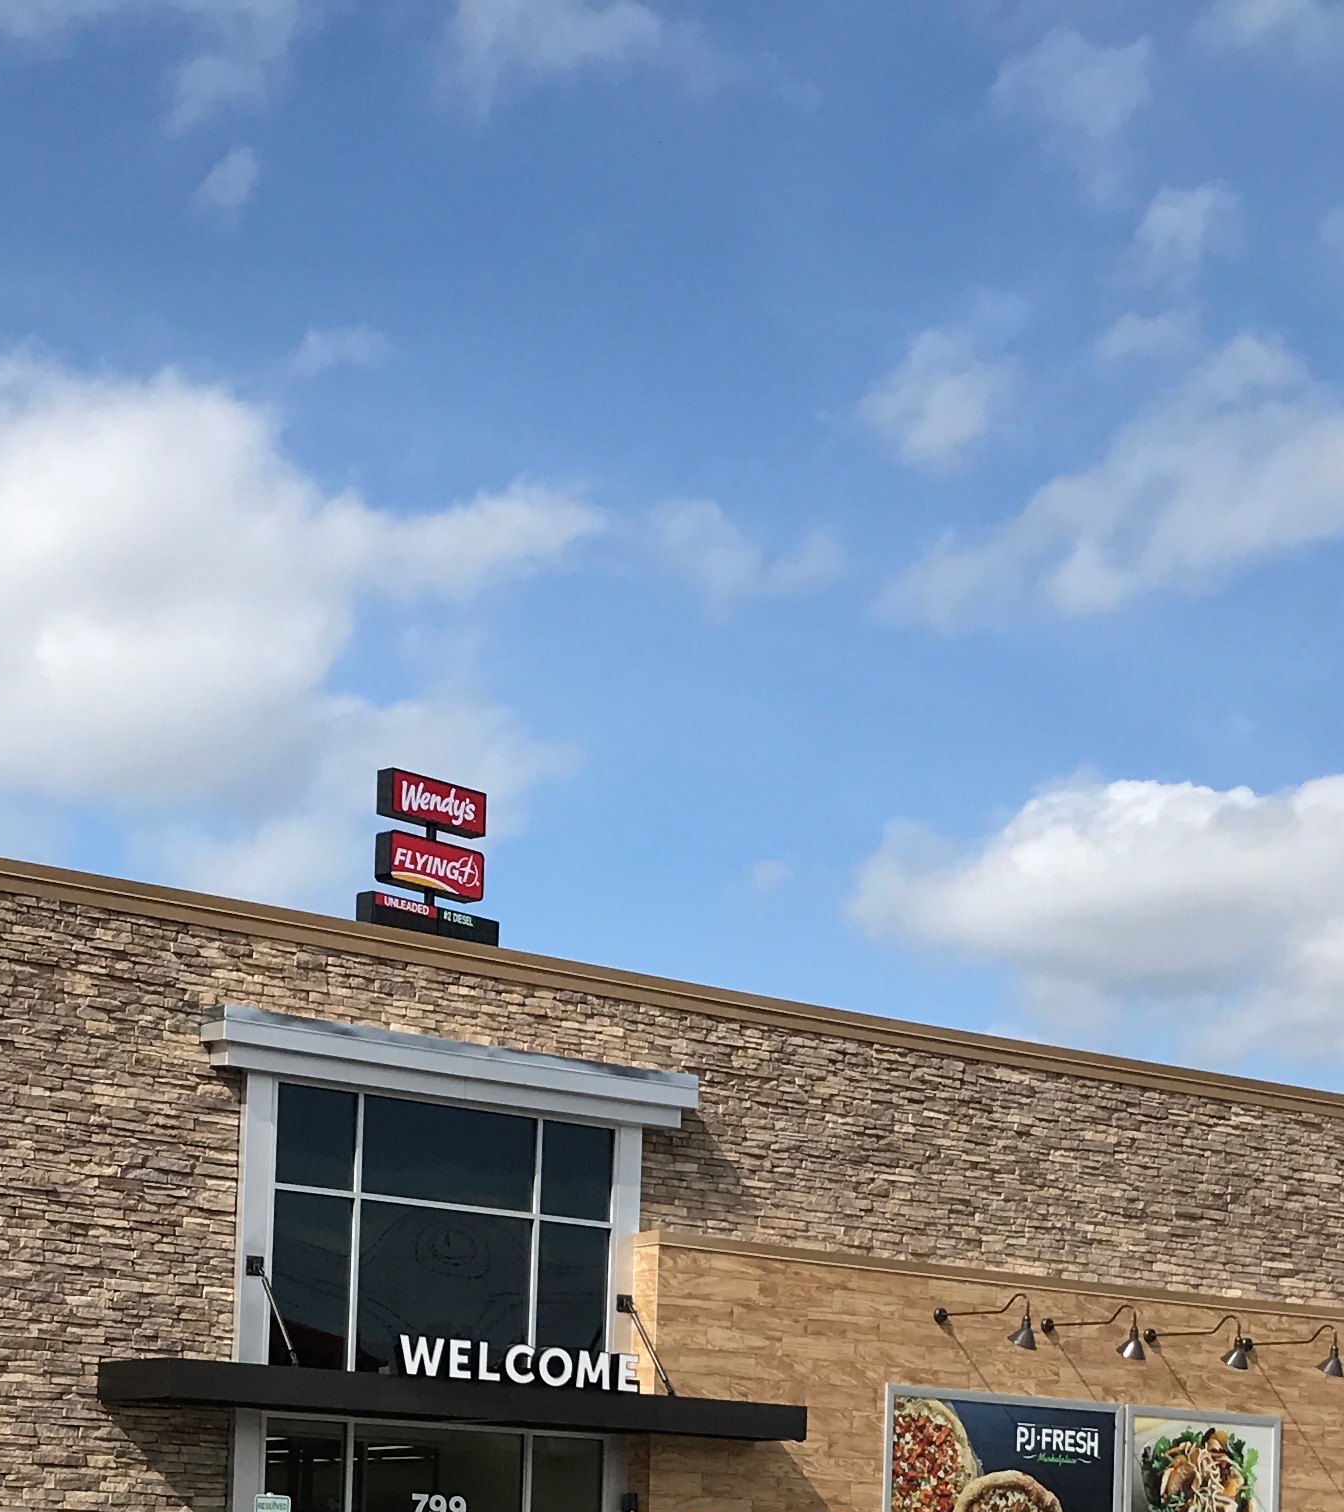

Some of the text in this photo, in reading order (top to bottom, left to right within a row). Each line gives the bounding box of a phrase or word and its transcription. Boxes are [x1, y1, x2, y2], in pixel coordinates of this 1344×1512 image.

[401, 780, 476, 826] Wendy's
[384, 896, 430, 916] UNLEADED
[453, 912, 474, 927] DIESEL
[399, 1334, 639, 1393] WELCOME
[257, 1501, 287, 1511] RESERVED
